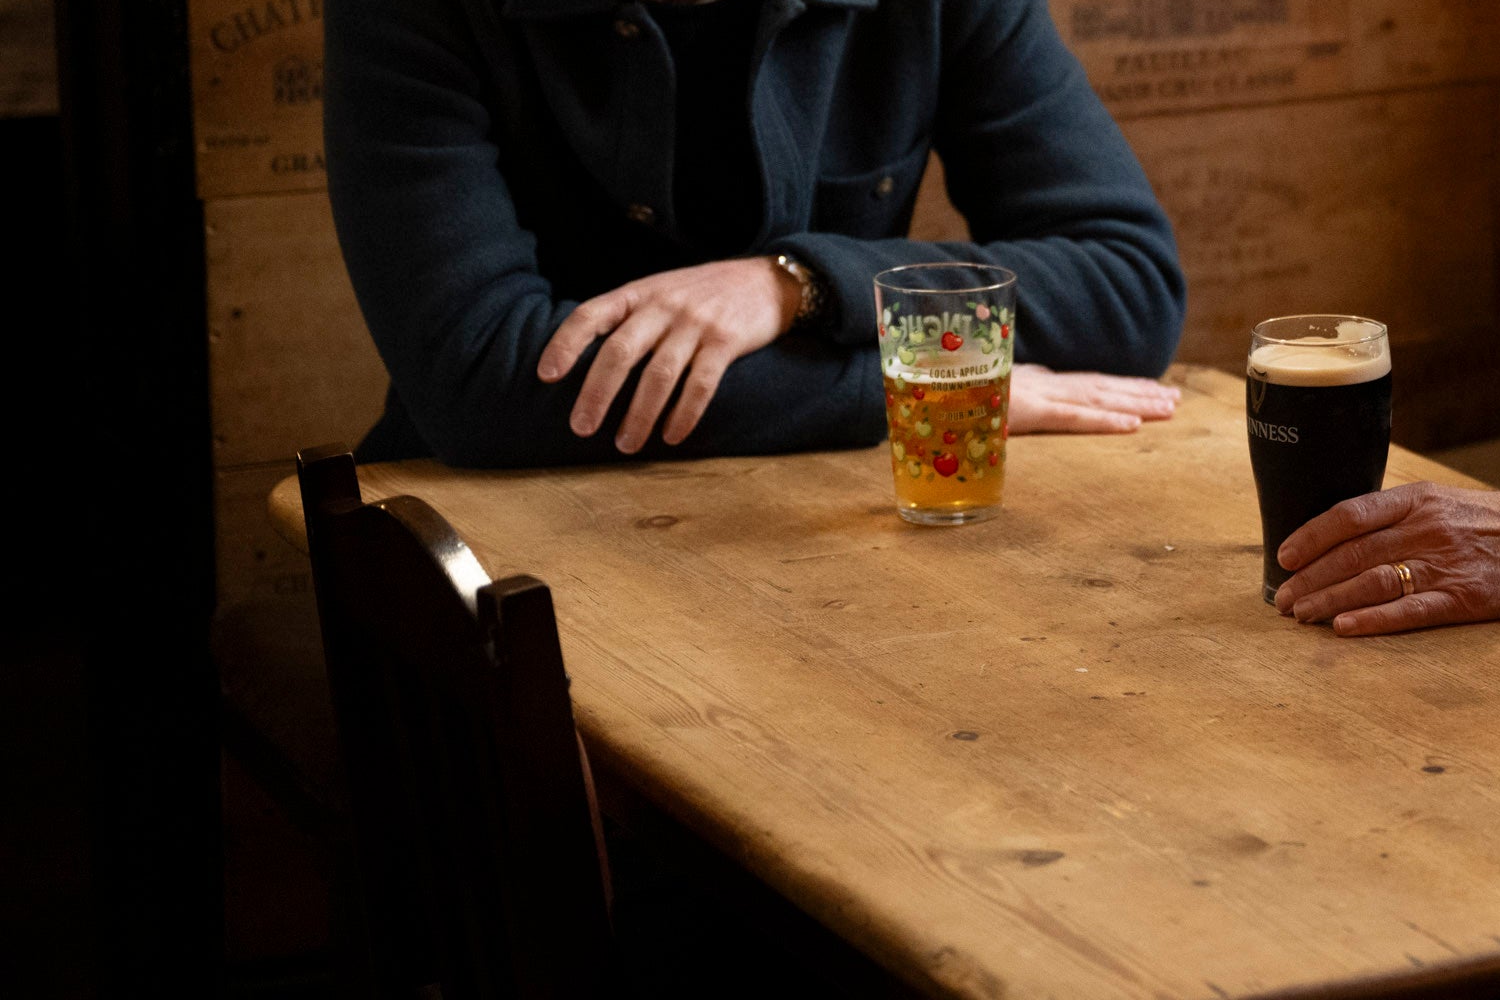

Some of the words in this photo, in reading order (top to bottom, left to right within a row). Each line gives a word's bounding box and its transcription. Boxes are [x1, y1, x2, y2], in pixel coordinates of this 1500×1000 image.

[929, 367, 957, 380] LOCAL
[959, 364, 989, 378] APPLES
[931, 380, 963, 392] GROWN
[1248, 416, 1299, 444] INNESS
